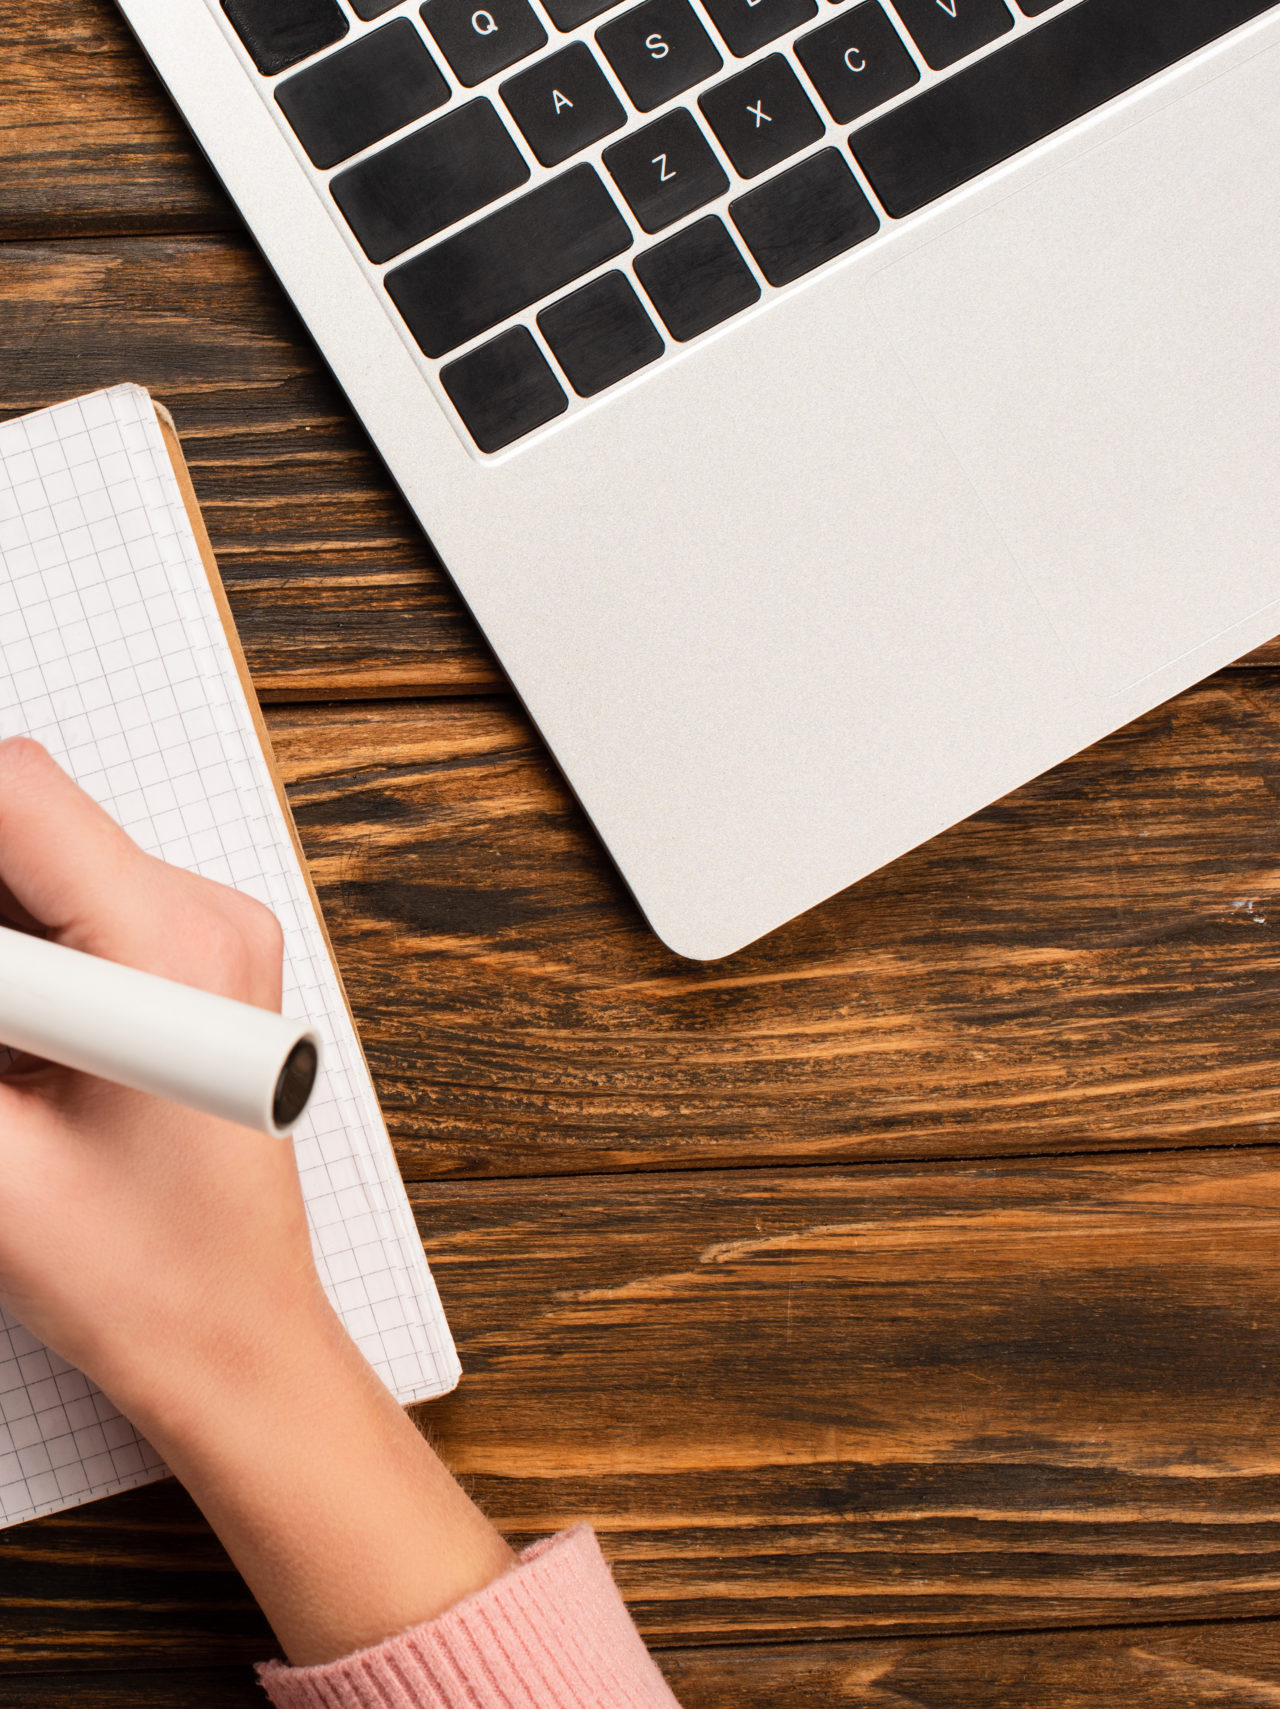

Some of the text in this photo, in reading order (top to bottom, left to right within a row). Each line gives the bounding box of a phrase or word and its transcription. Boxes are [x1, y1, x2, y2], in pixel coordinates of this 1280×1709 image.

[471, 9, 499, 36] Q
[645, 33, 670, 60] S
[844, 47, 866, 73] C
[552, 89, 574, 115] A
[746, 99, 773, 128] X
[651, 153, 677, 182] Z
